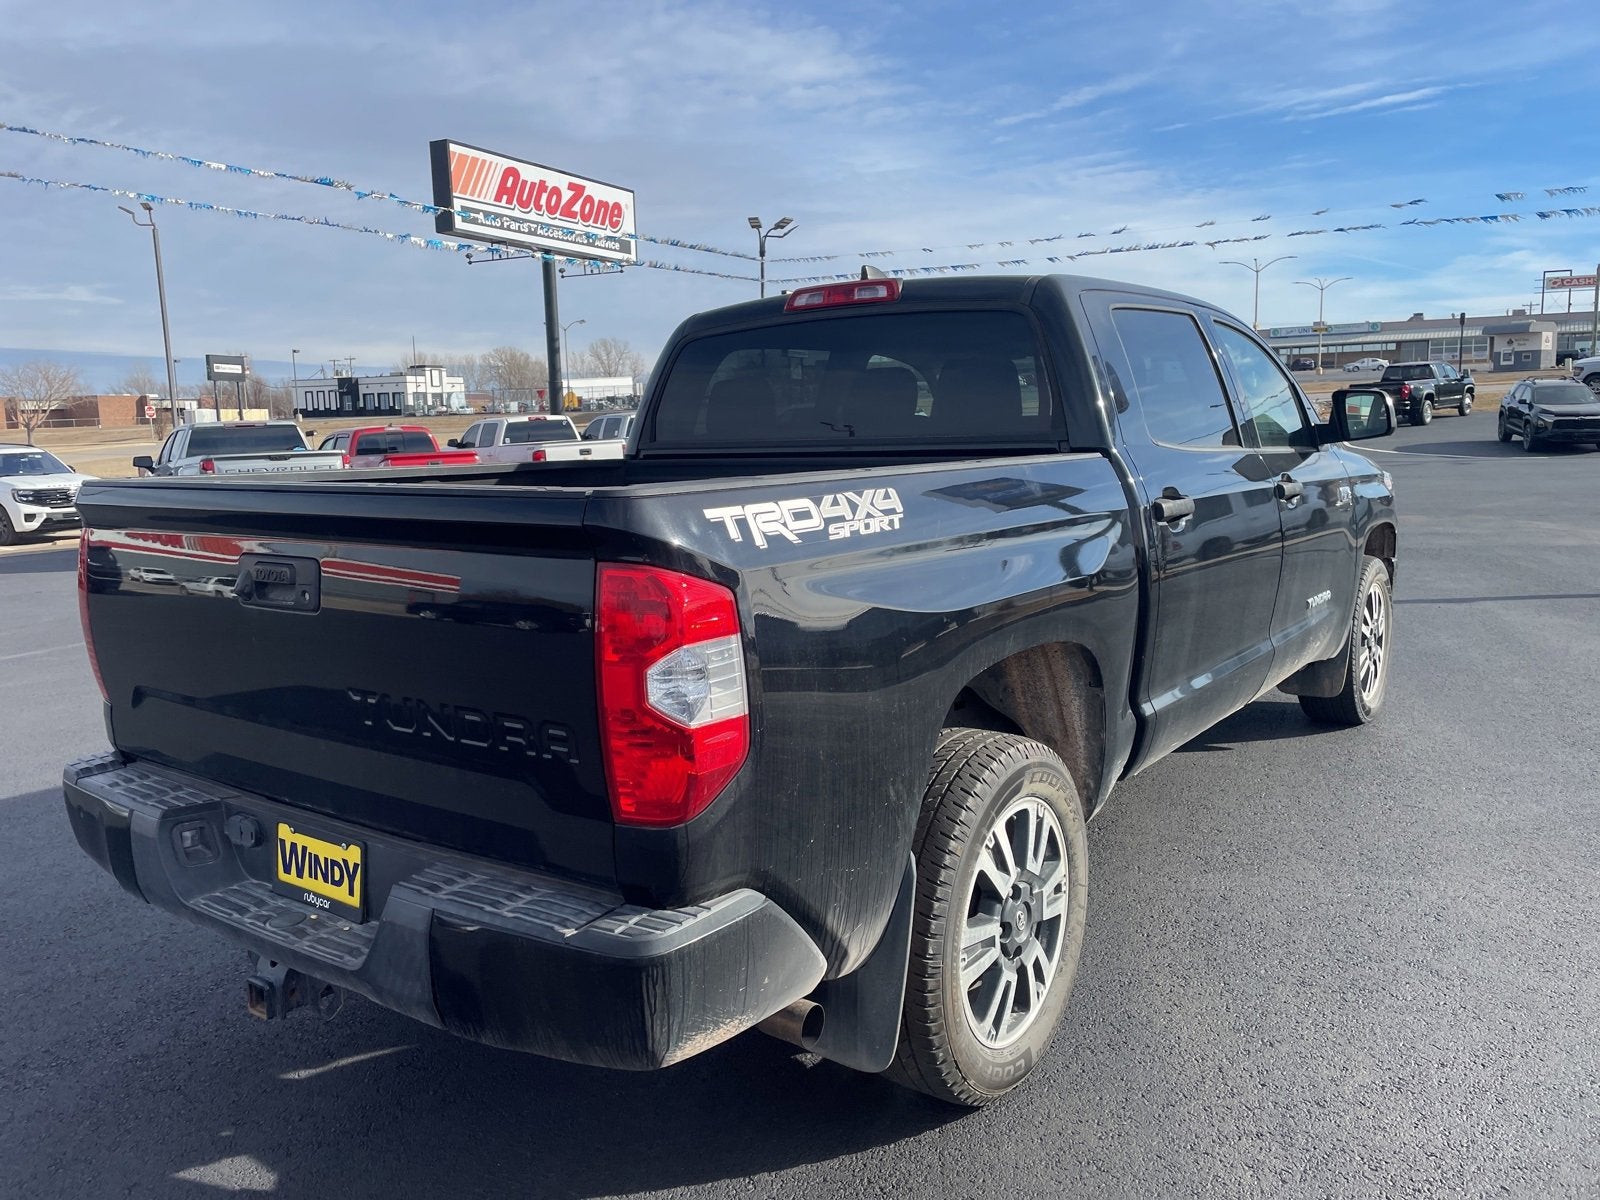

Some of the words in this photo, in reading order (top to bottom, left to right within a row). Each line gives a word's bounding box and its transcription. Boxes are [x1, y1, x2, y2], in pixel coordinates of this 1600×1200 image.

[493, 166, 624, 230] AutoZone
[478, 211, 501, 227] Auto
[503, 217, 529, 232] Parts
[537, 223, 588, 243] Accessories
[595, 237, 620, 250] Advice
[703, 498, 825, 549] TRD
[828, 513, 904, 540] SPORT
[255, 567, 289, 582] TOYOTA
[347, 687, 580, 763] TUNDRA
[279, 838, 360, 898] WINDY
[304, 892, 331, 909] rubycar
